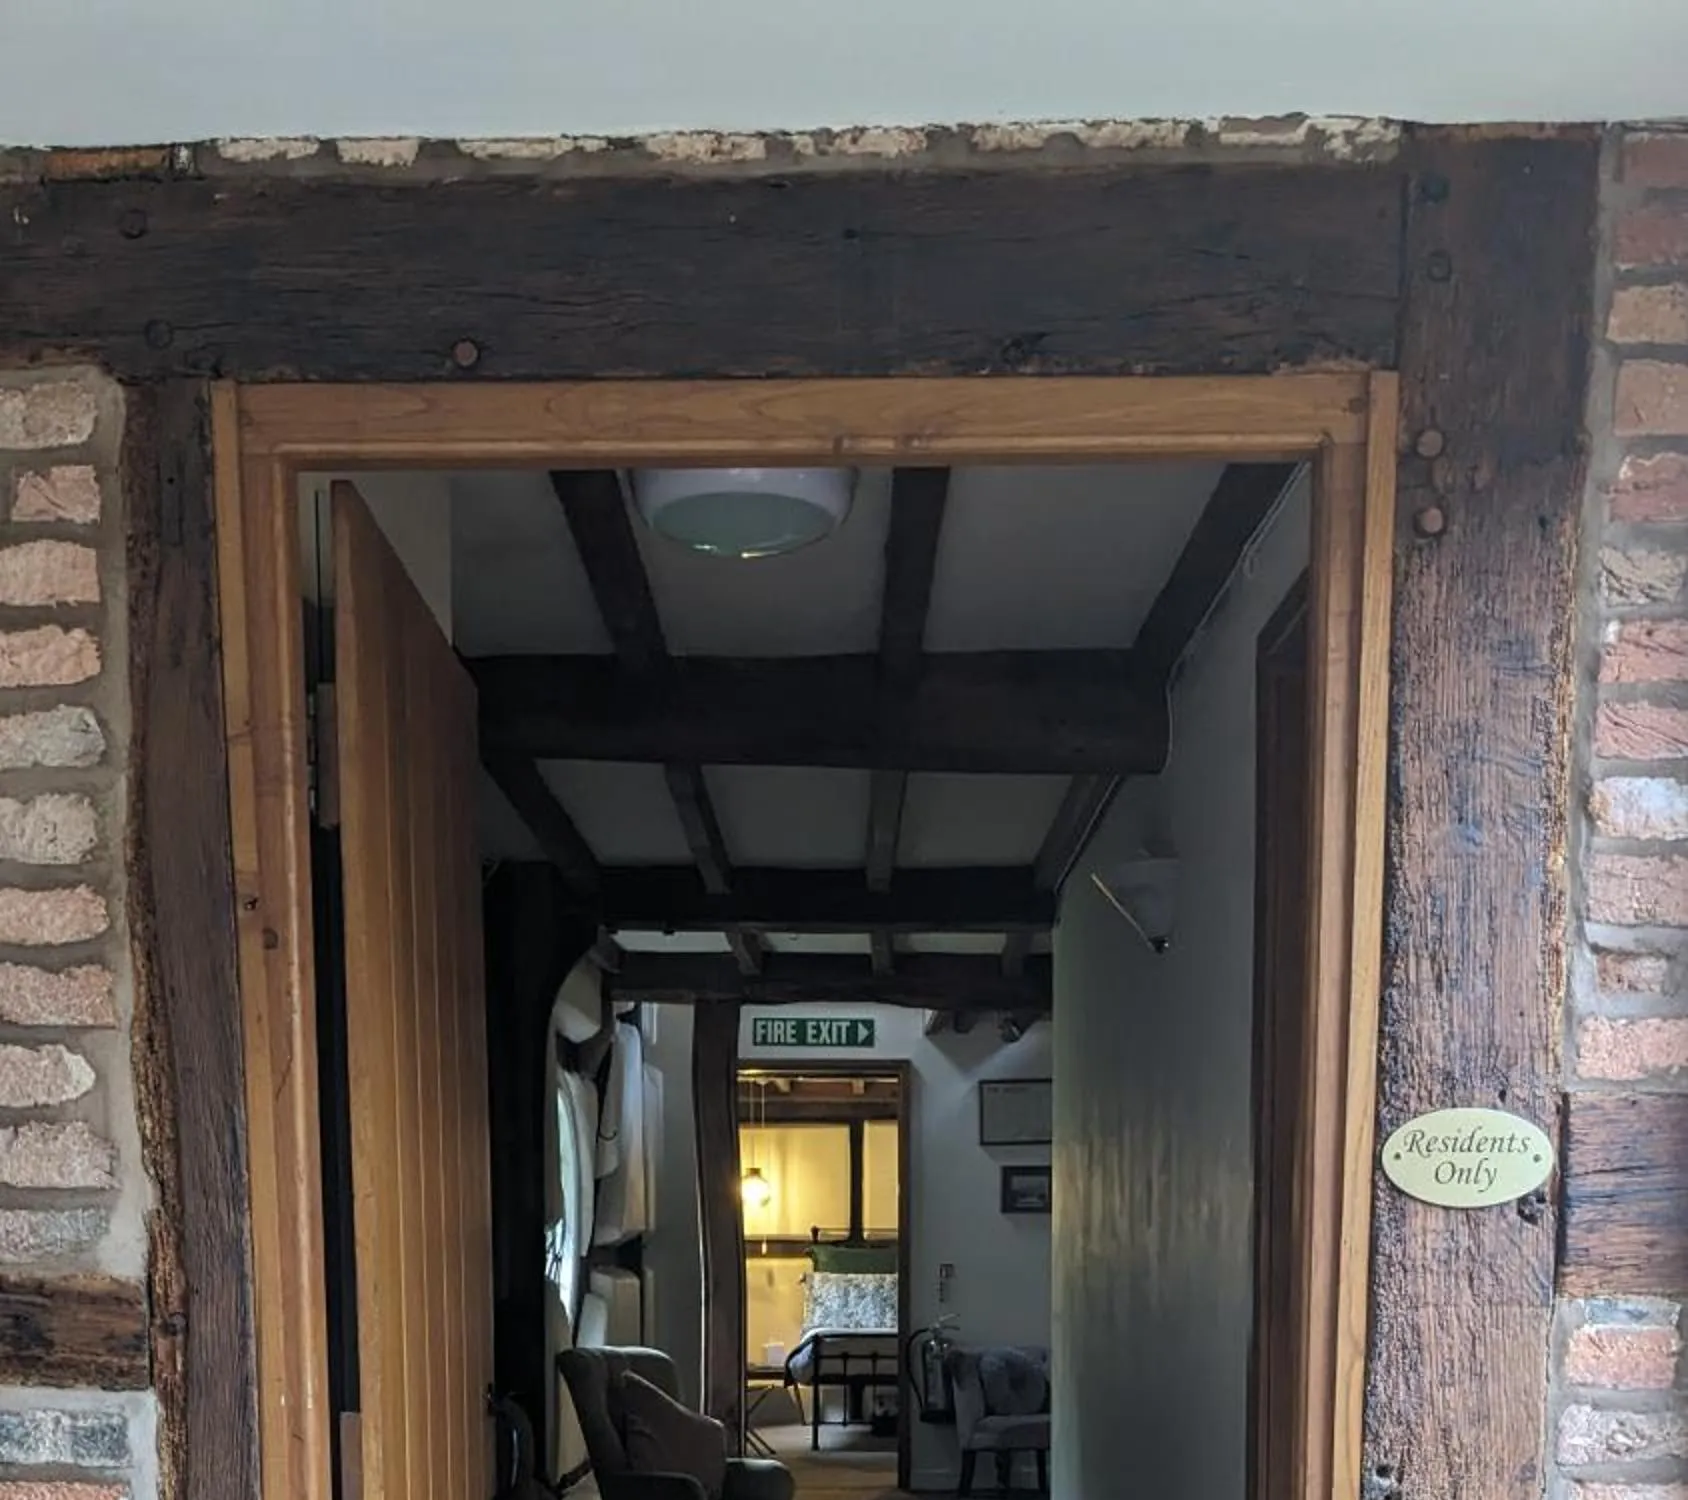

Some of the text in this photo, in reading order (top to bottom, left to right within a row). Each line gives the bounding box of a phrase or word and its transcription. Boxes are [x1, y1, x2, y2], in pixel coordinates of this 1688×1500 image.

[756, 1019, 850, 1045] FIRE EXIT
[1403, 1126, 1531, 1158] Residents
[1434, 1157, 1498, 1193] Only
